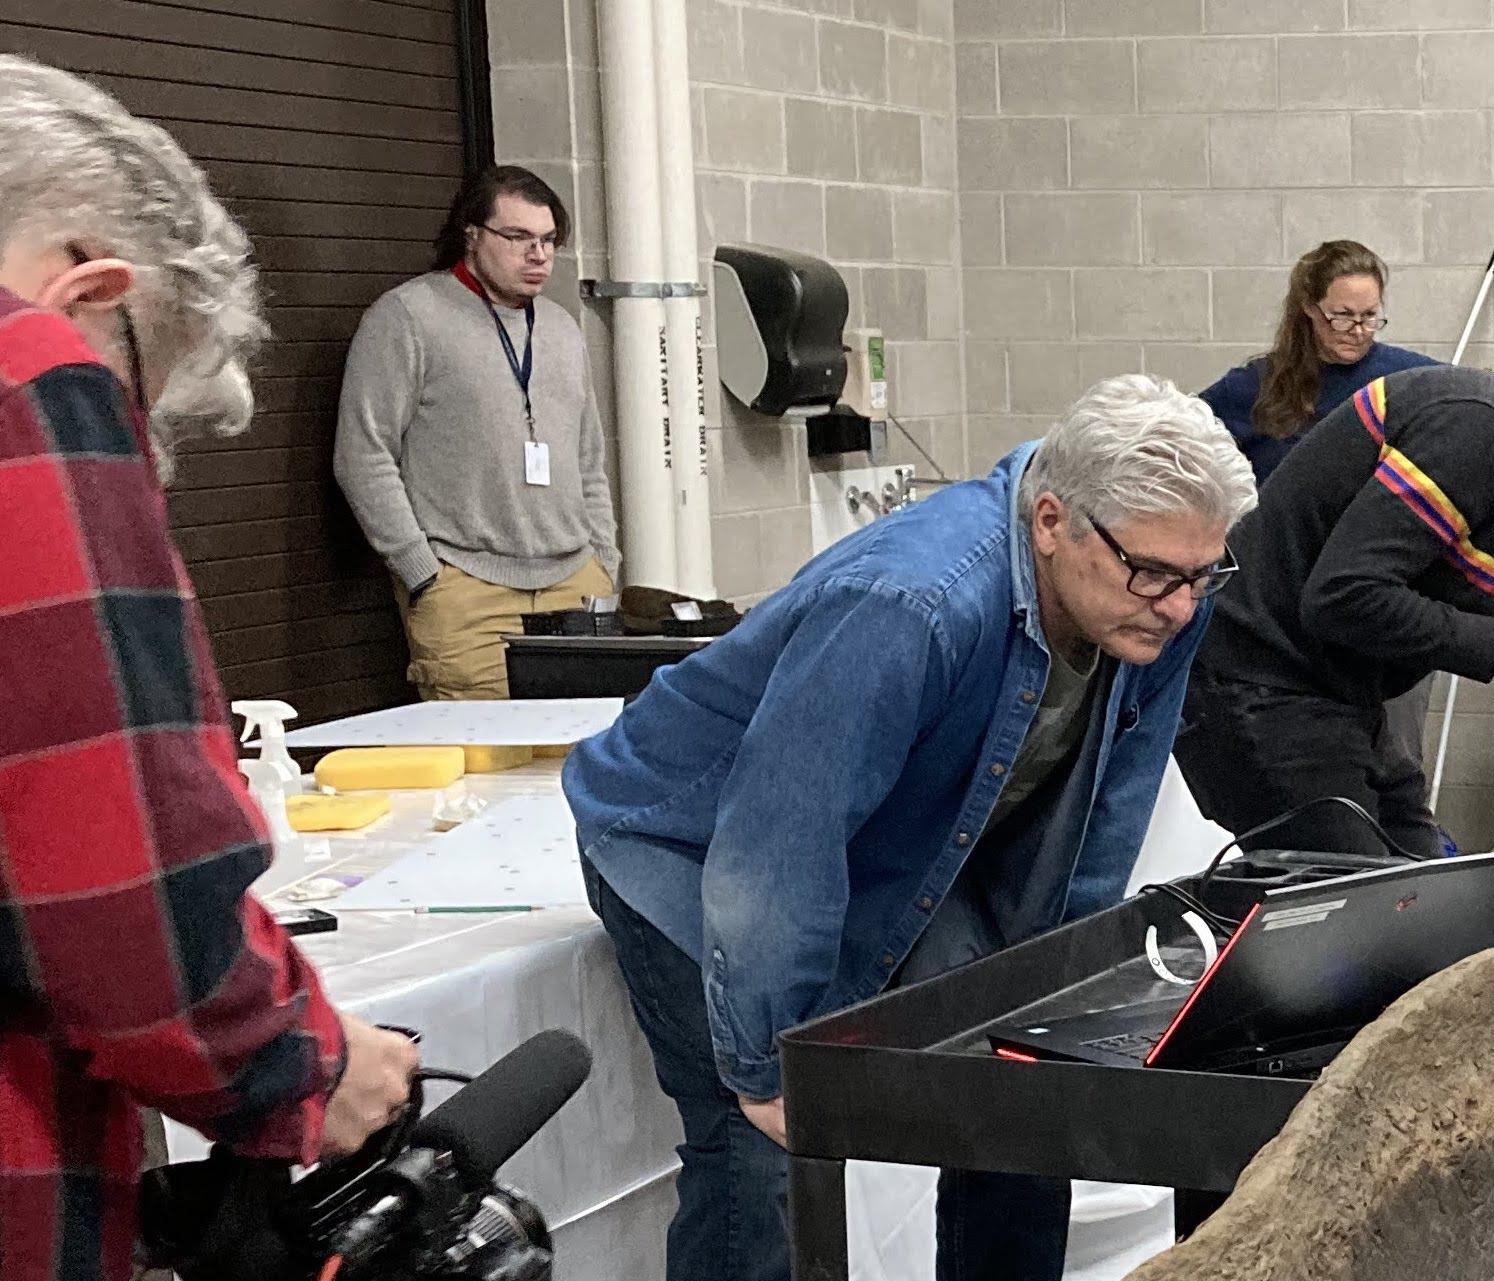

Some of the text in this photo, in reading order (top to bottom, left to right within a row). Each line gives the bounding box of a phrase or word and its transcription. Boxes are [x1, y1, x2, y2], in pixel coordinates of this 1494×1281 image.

[659, 326, 672, 469] SANITARY DRAIN
[699, 425, 708, 476] DRAIN
